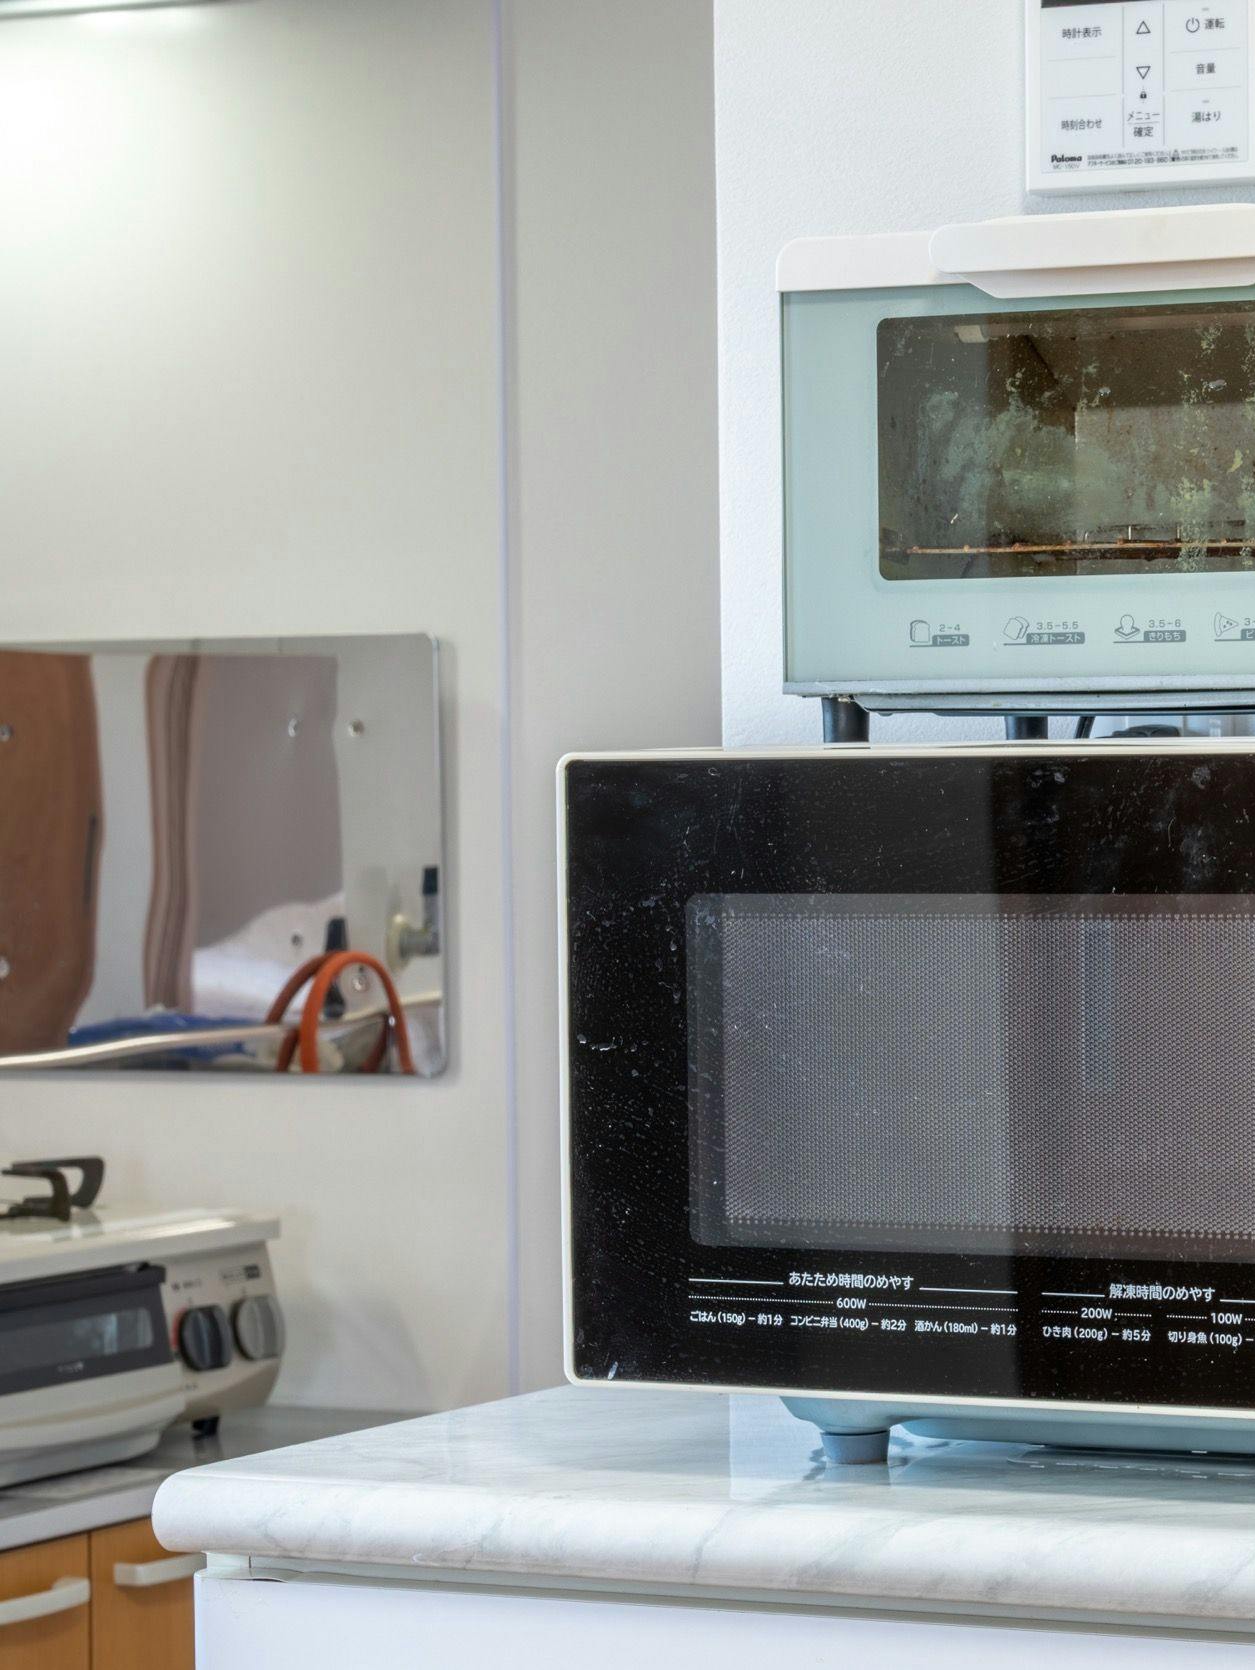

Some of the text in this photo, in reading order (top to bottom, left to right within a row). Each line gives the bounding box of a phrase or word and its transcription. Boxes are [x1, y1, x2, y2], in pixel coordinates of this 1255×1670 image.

[1204, 18, 1225, 30] 運転
[1061, 26, 1102, 39] 時計表示
[1195, 63, 1216, 75] 音量
[1127, 111, 1160, 122] メニュー
[1191, 111, 1222, 123] 湯はり
[1060, 119, 1102, 131] 時刻合わせ
[1133, 126, 1154, 138] 確定
[1051, 153, 1082, 164] Paloma
[939, 623, 961, 633] 2-4
[936, 636, 967, 646] トースト
[789, 1271, 914, 1290] あたため時間のめやす
[1109, 1283, 1216, 1301] 解凍時間のめやす
[836, 1298, 866, 1310] 600W
[1081, 1308, 1113, 1320] 200W
[1211, 1312, 1242, 1325] 100W
